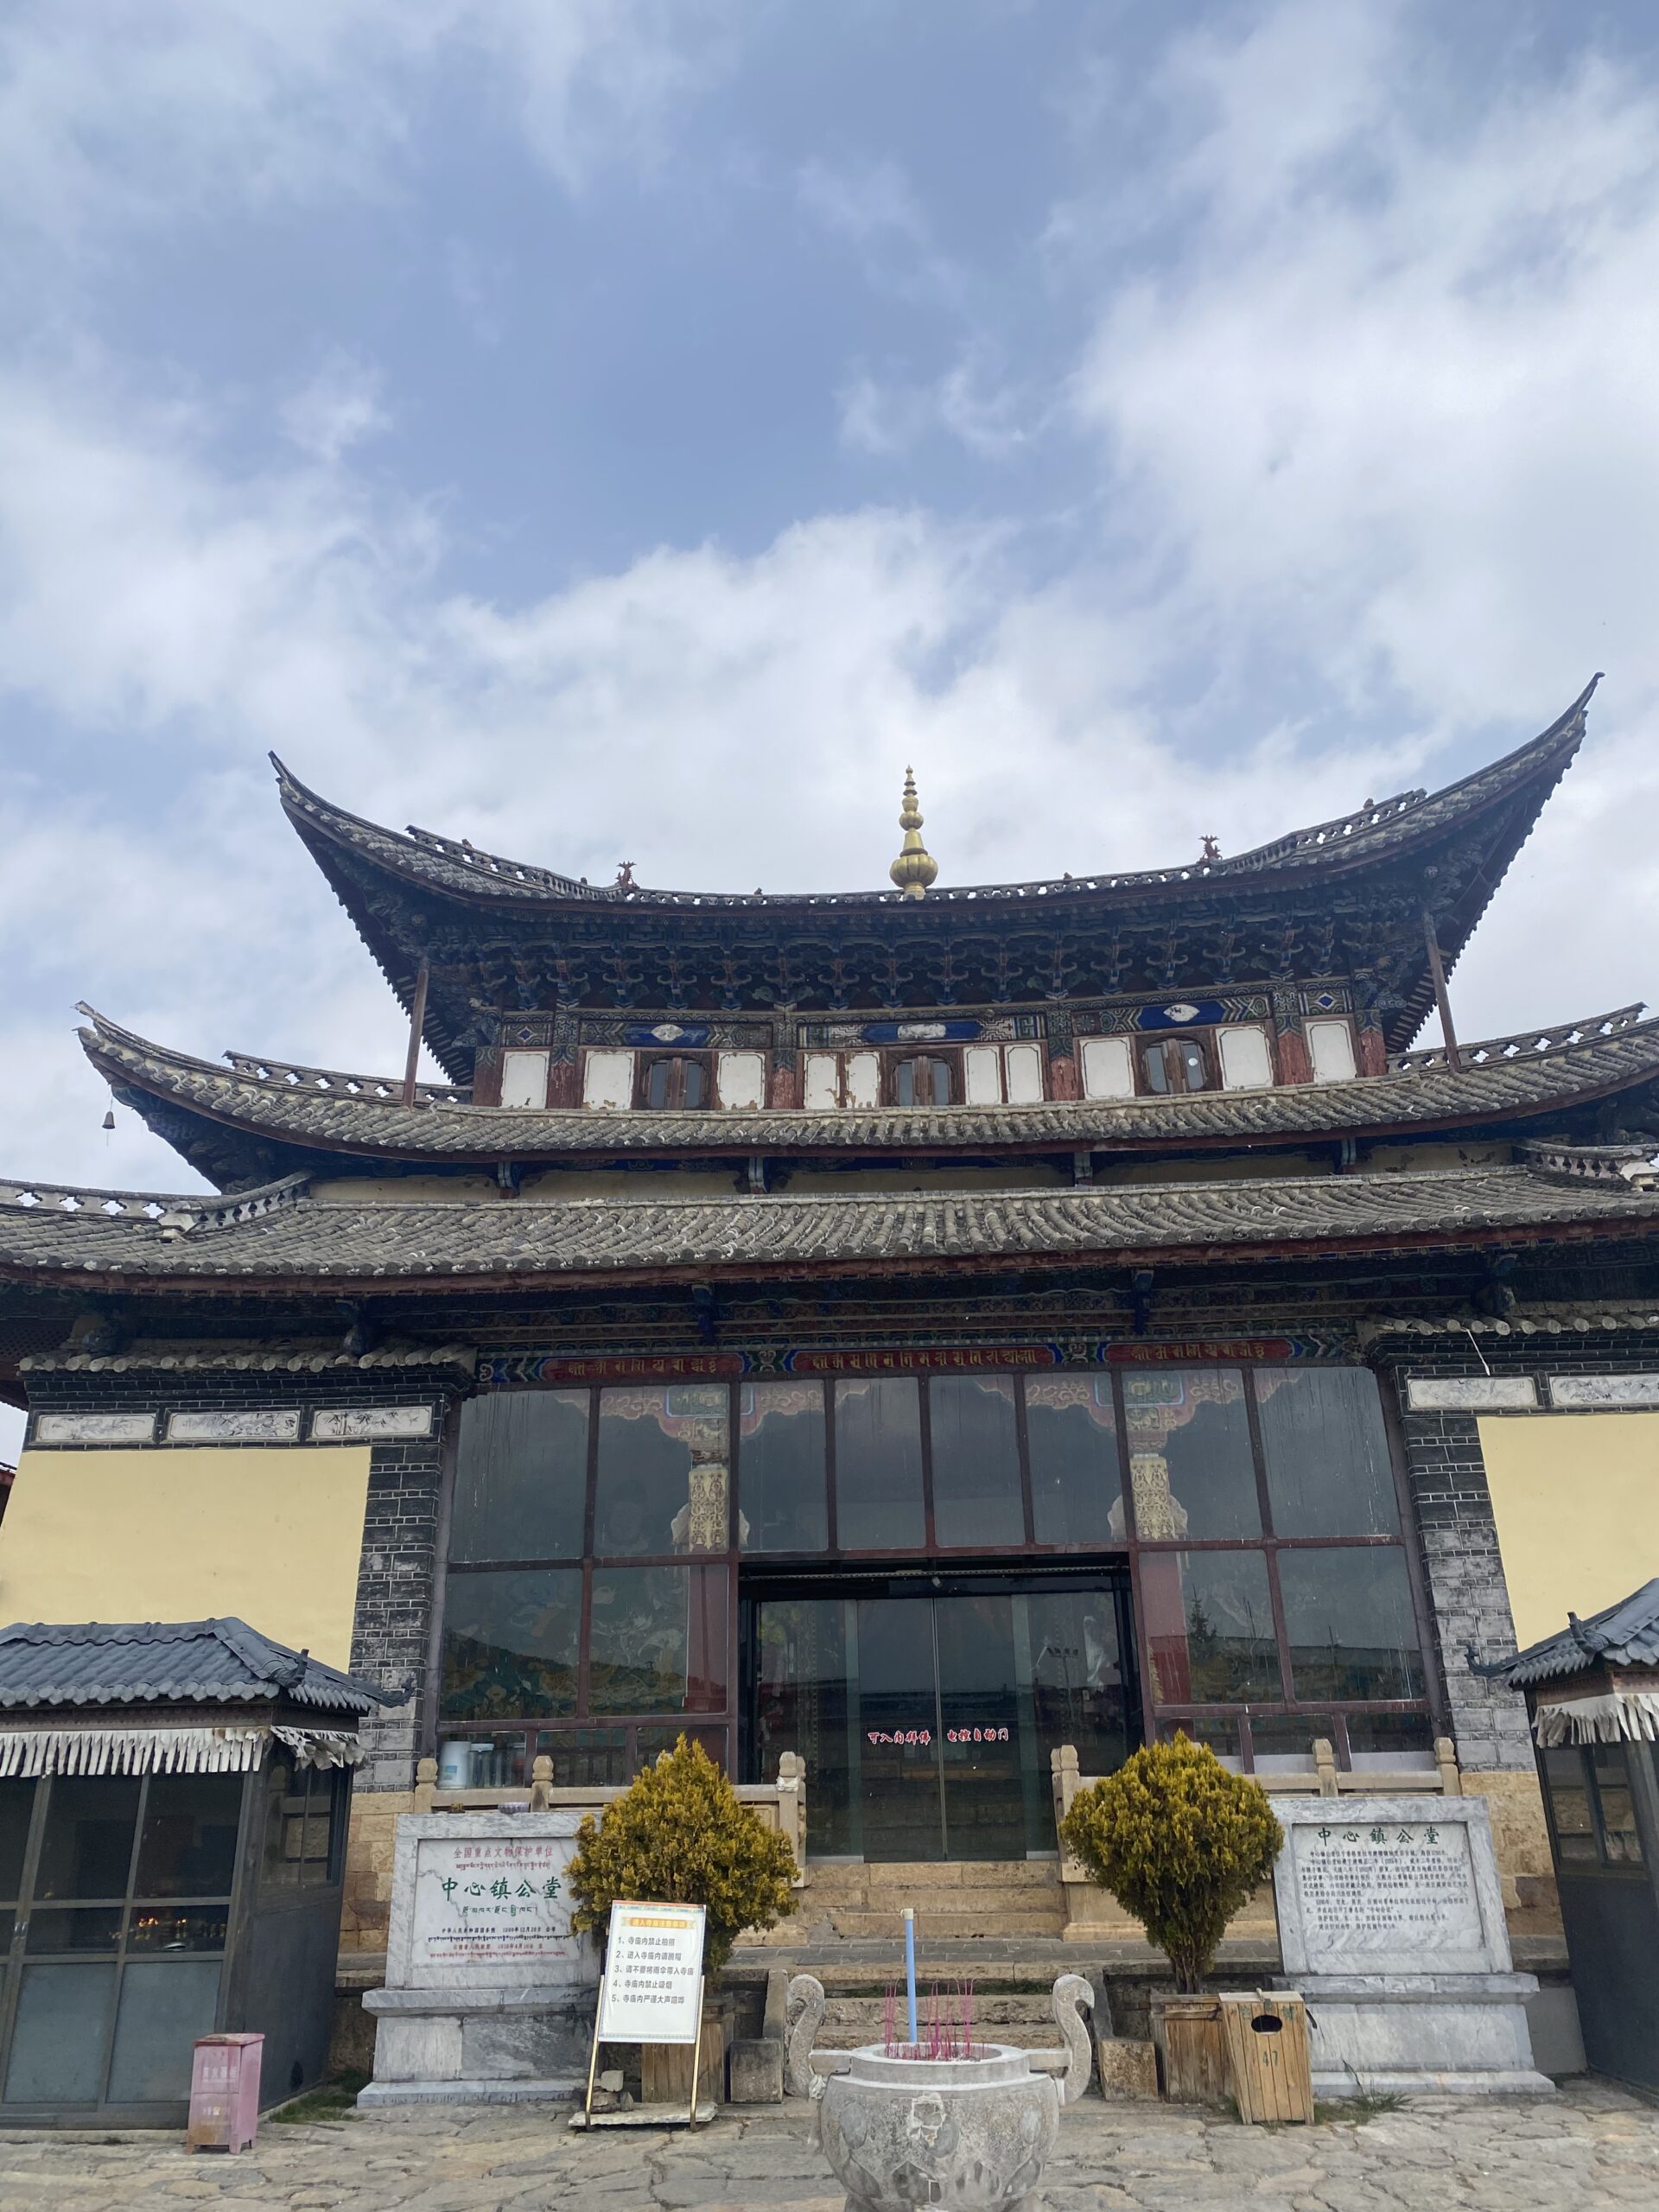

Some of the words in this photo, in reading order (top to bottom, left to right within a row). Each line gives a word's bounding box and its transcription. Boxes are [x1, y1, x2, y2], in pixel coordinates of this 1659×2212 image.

[868, 1730, 931, 1745] 可入内拜佛
[947, 1728, 1008, 1742] 电控自动门
[454, 1846, 553, 1859] 全国重点文物保护单位
[442, 1876, 562, 1901] 中心镇公堂
[618, 1936, 676, 1947] 1、寺庙内禁止拍照
[616, 1951, 682, 1961] 2、进入寺庙内请脱帽
[614, 1965, 694, 1976] 3、请不要将雨伞带入寺庙
[613, 1980, 672, 1990] 4、寺庙内禁止吸烟
[1262, 2050, 1279, 2067] 47
